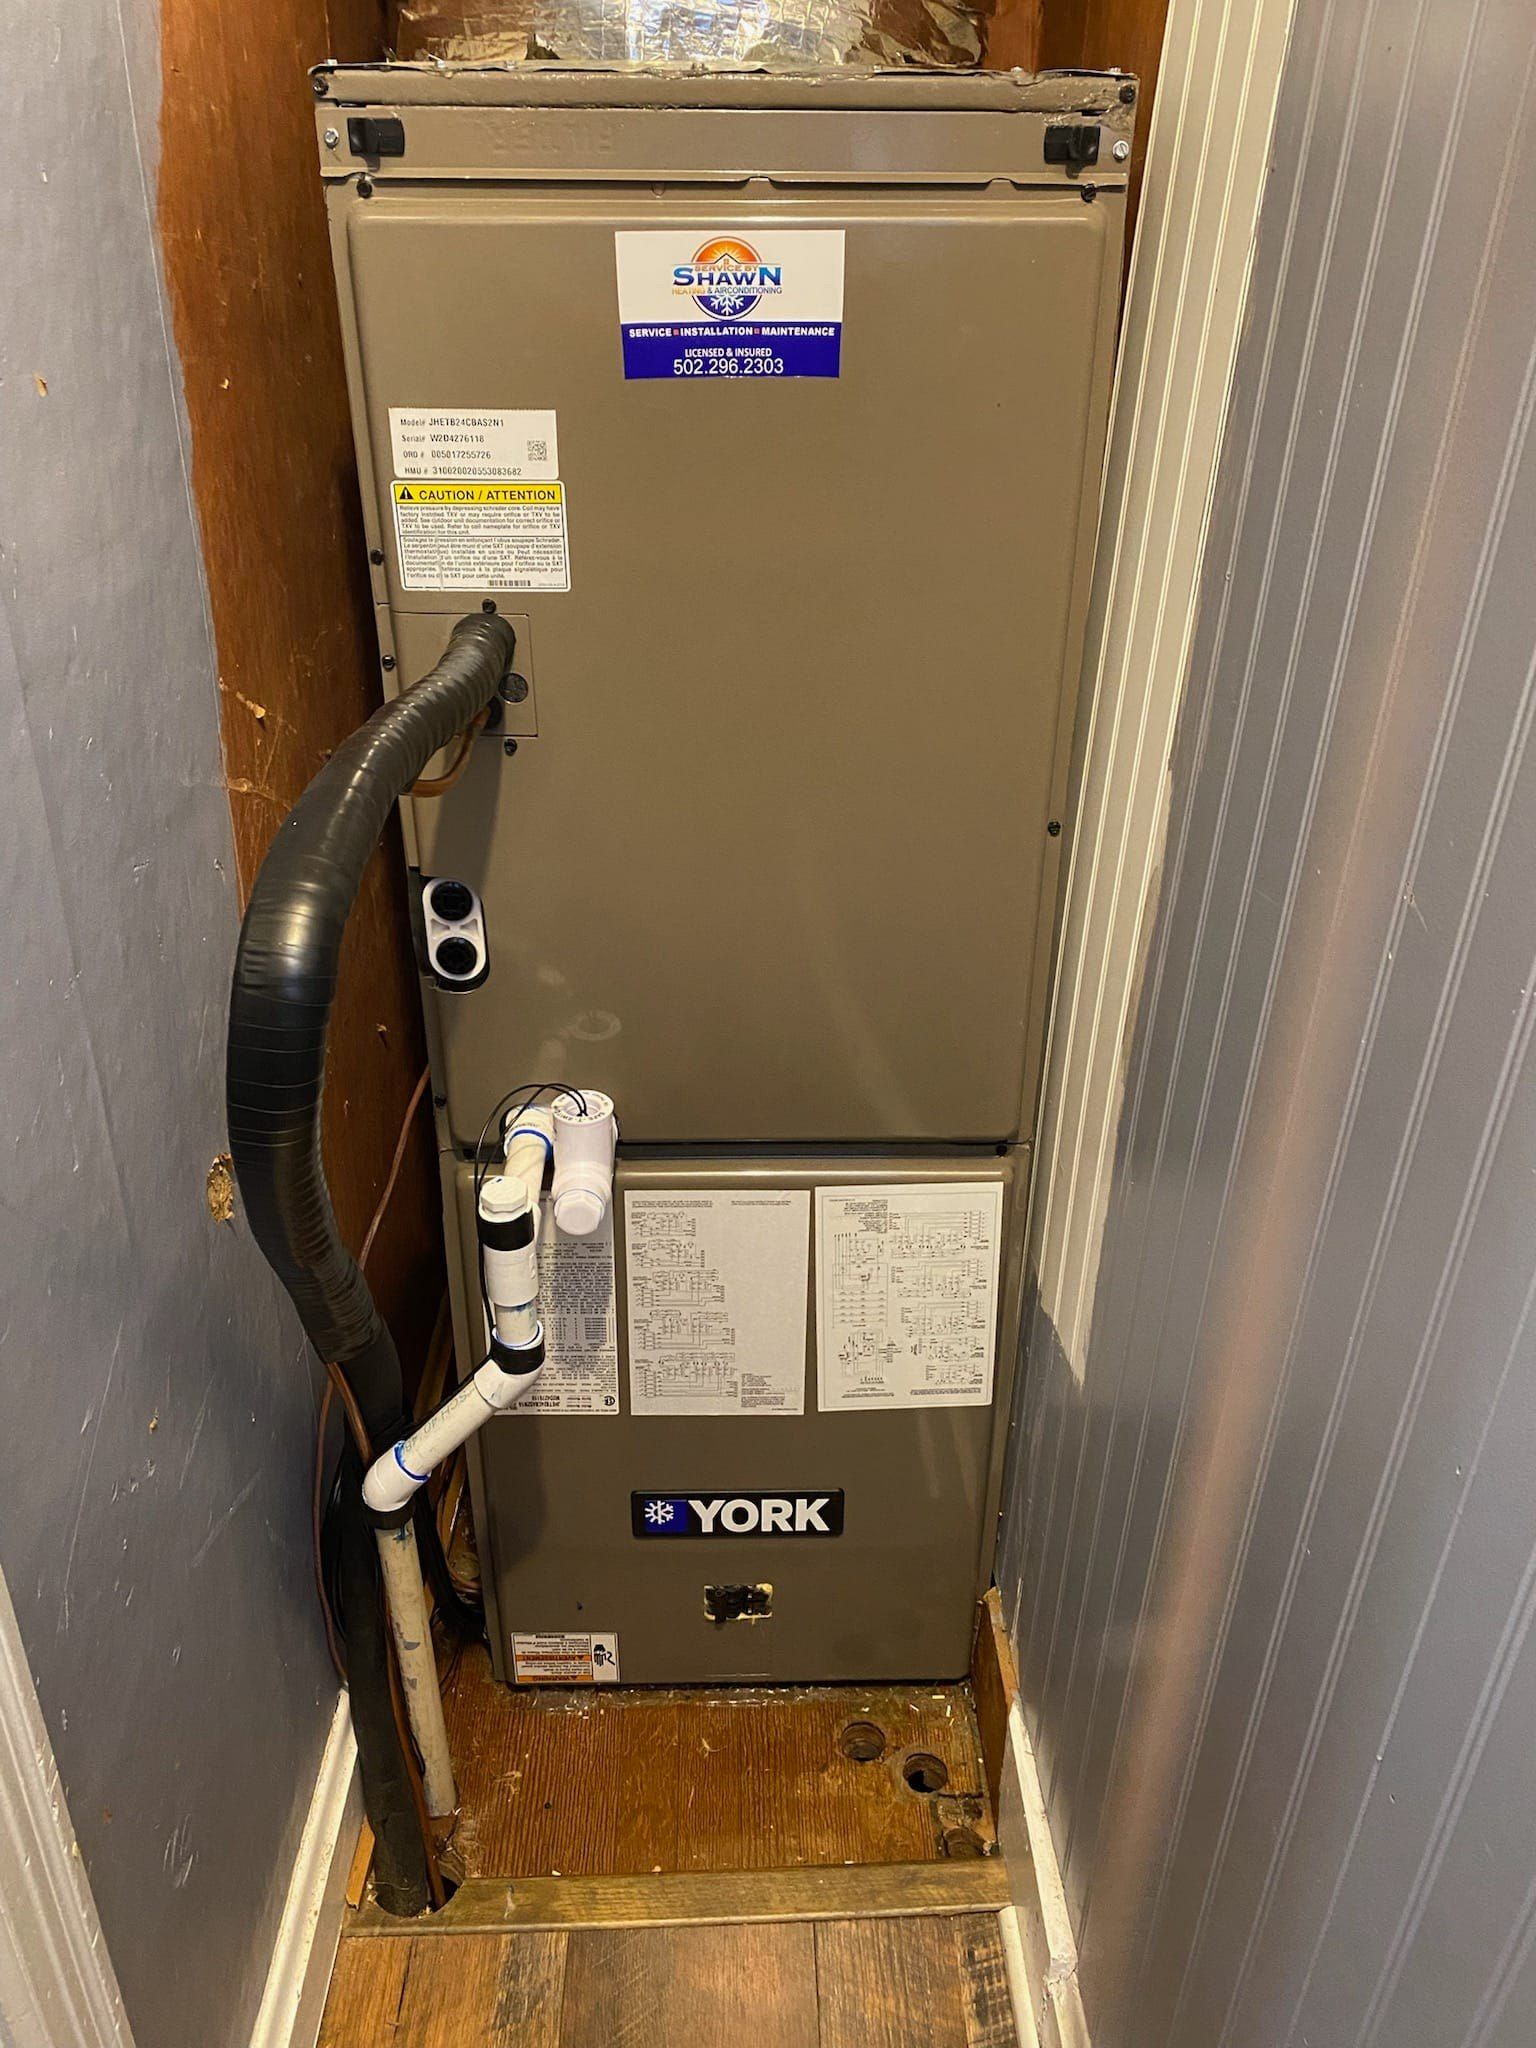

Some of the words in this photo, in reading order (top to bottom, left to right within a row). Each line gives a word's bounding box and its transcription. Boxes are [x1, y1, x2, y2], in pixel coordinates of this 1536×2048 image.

[694, 264, 734, 273] SERVICE
[739, 264, 758, 273] BY
[673, 266, 782, 286] SHAWN
[671, 287, 705, 296] HEATING
[707, 287, 714, 295] &
[714, 287, 782, 295] AIRCONDITIONING
[628, 328, 672, 338] SERVICE
[680, 327, 754, 337] INSTALLATION
[761, 327, 835, 337] MAINTENANCE
[684, 347, 725, 358] LICENSED
[726, 347, 733, 357] &
[734, 347, 772, 357] INSURED
[673, 358, 784, 375] 502.296.2303
[419, 490, 475, 500] CAUTION
[478, 490, 483, 500] /
[486, 490, 555, 500] ATTENTION
[688, 1498, 830, 1533] YORK
